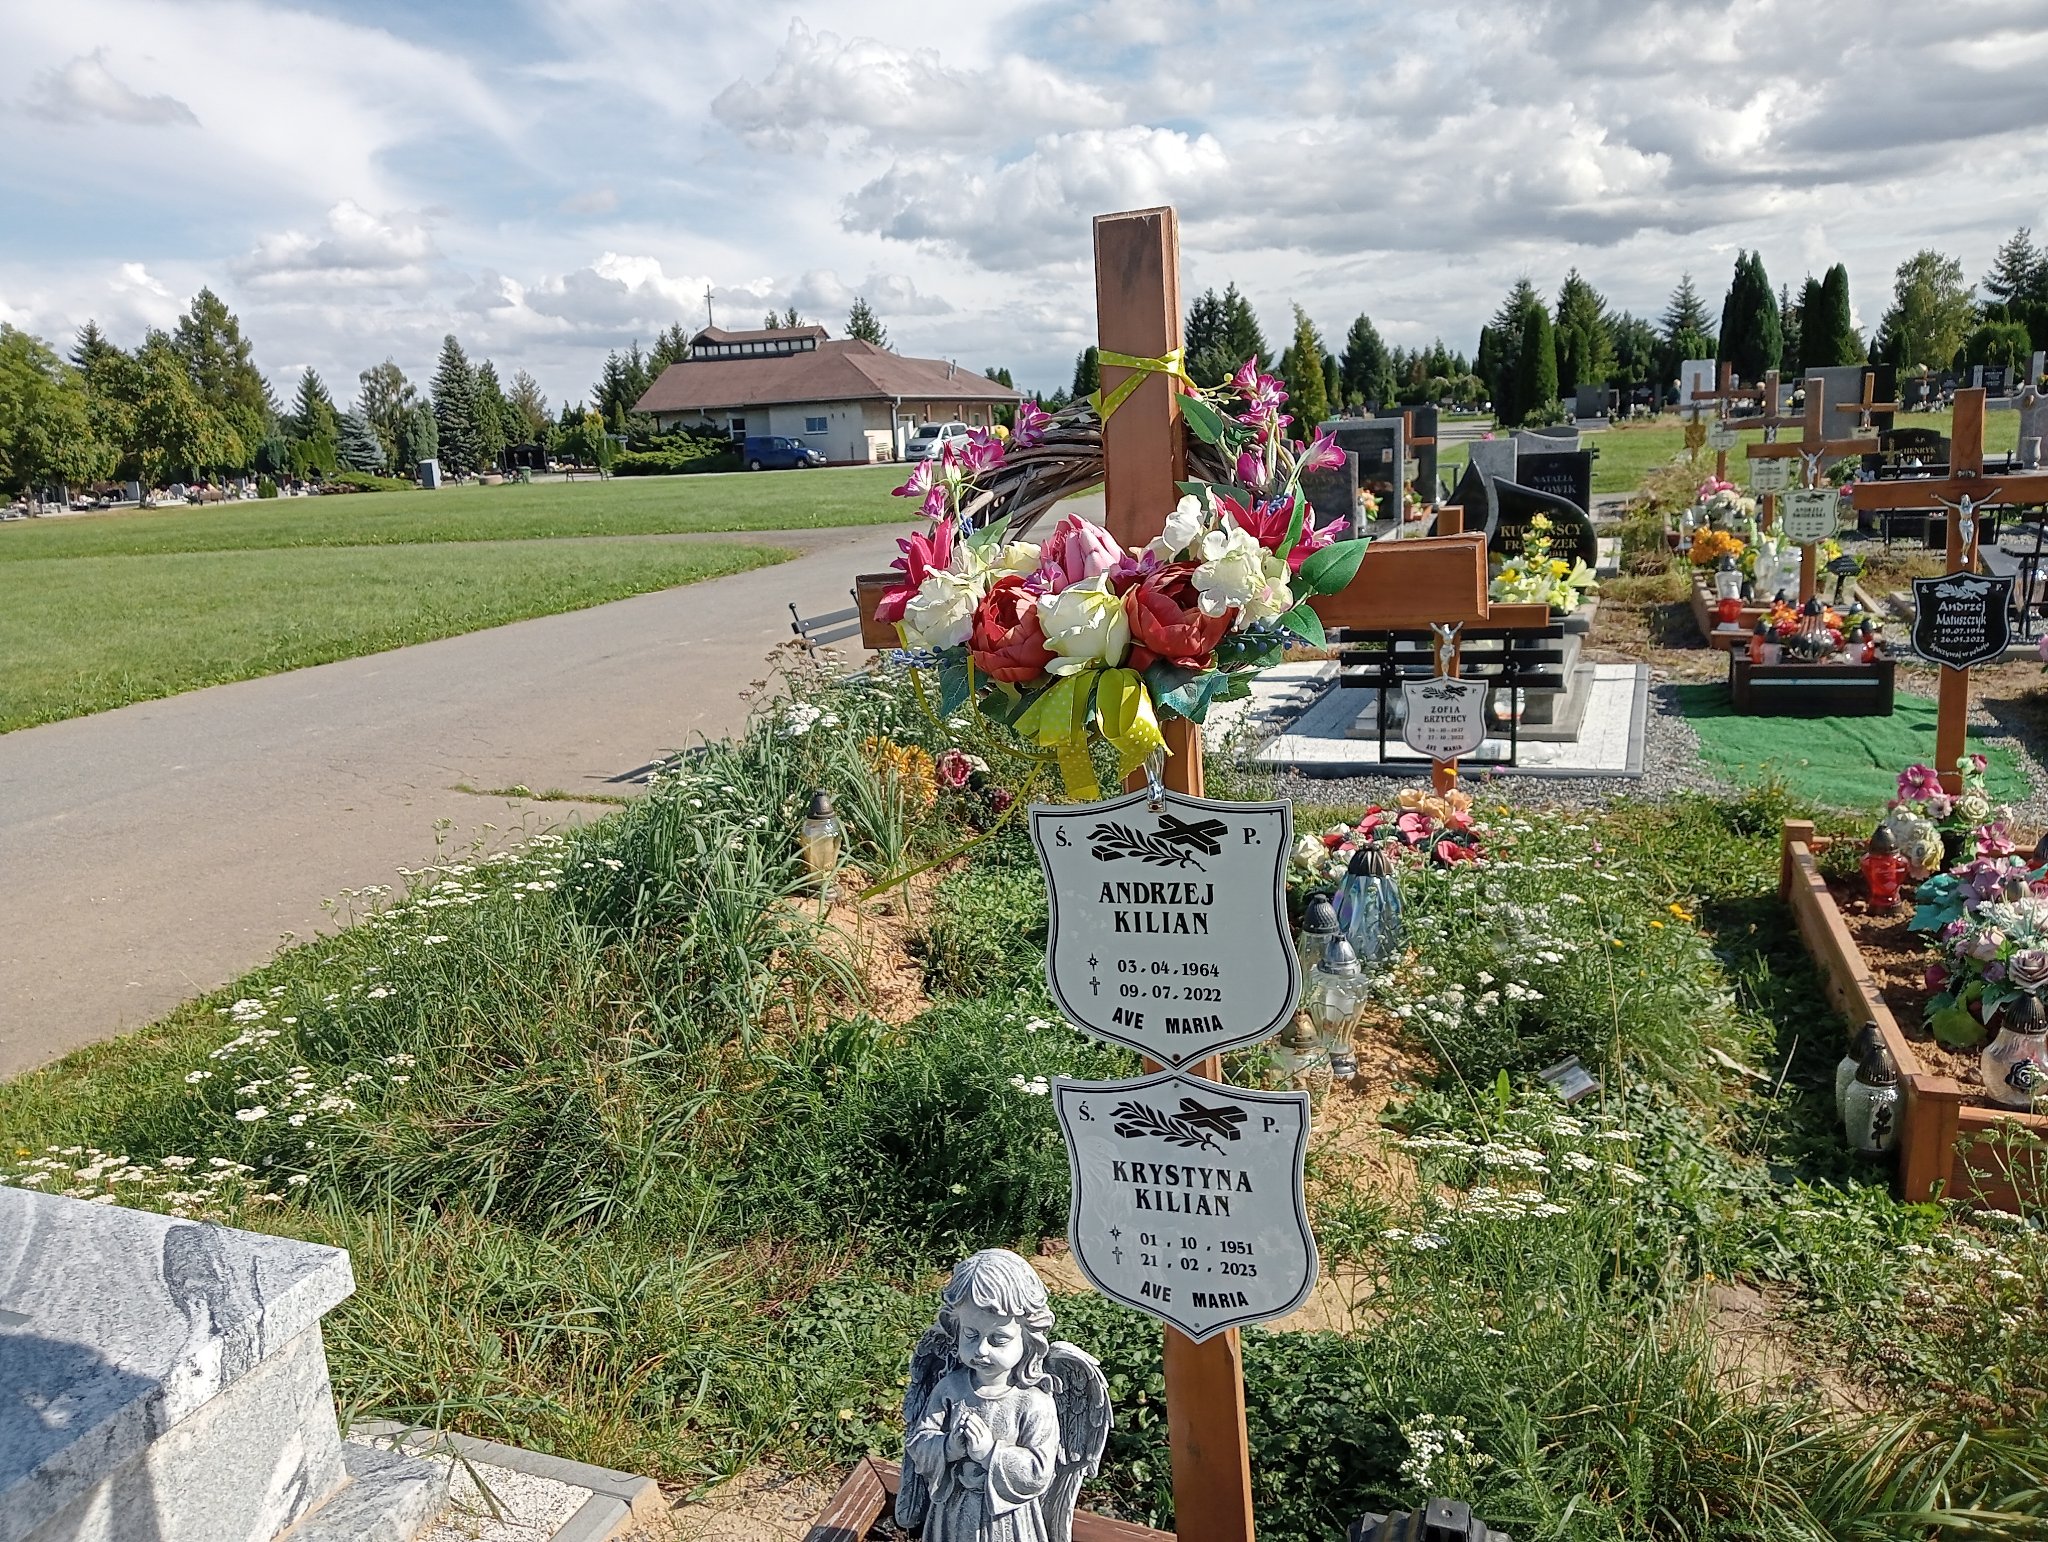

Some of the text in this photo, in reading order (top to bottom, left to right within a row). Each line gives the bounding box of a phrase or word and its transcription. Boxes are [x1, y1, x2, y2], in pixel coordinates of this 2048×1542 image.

[1903, 446, 1936, 455] HENRYK
[1938, 601, 1986, 613] Andrzej
[1936, 613, 1987, 628] Matuszczyk
[1056, 825, 1261, 847] Ś. P.
[1098, 881, 1214, 906] ANDRZEJ
[1113, 910, 1209, 935] KILIAN
[1111, 1006, 1224, 1035] AVE MARIA
[1078, 1100, 1280, 1134] Ś. P.
[1111, 1160, 1254, 1193] KRYSTYNA
[1134, 1188, 1232, 1218] KILIAN
[1139, 1280, 1250, 1309] AVE MARIA
